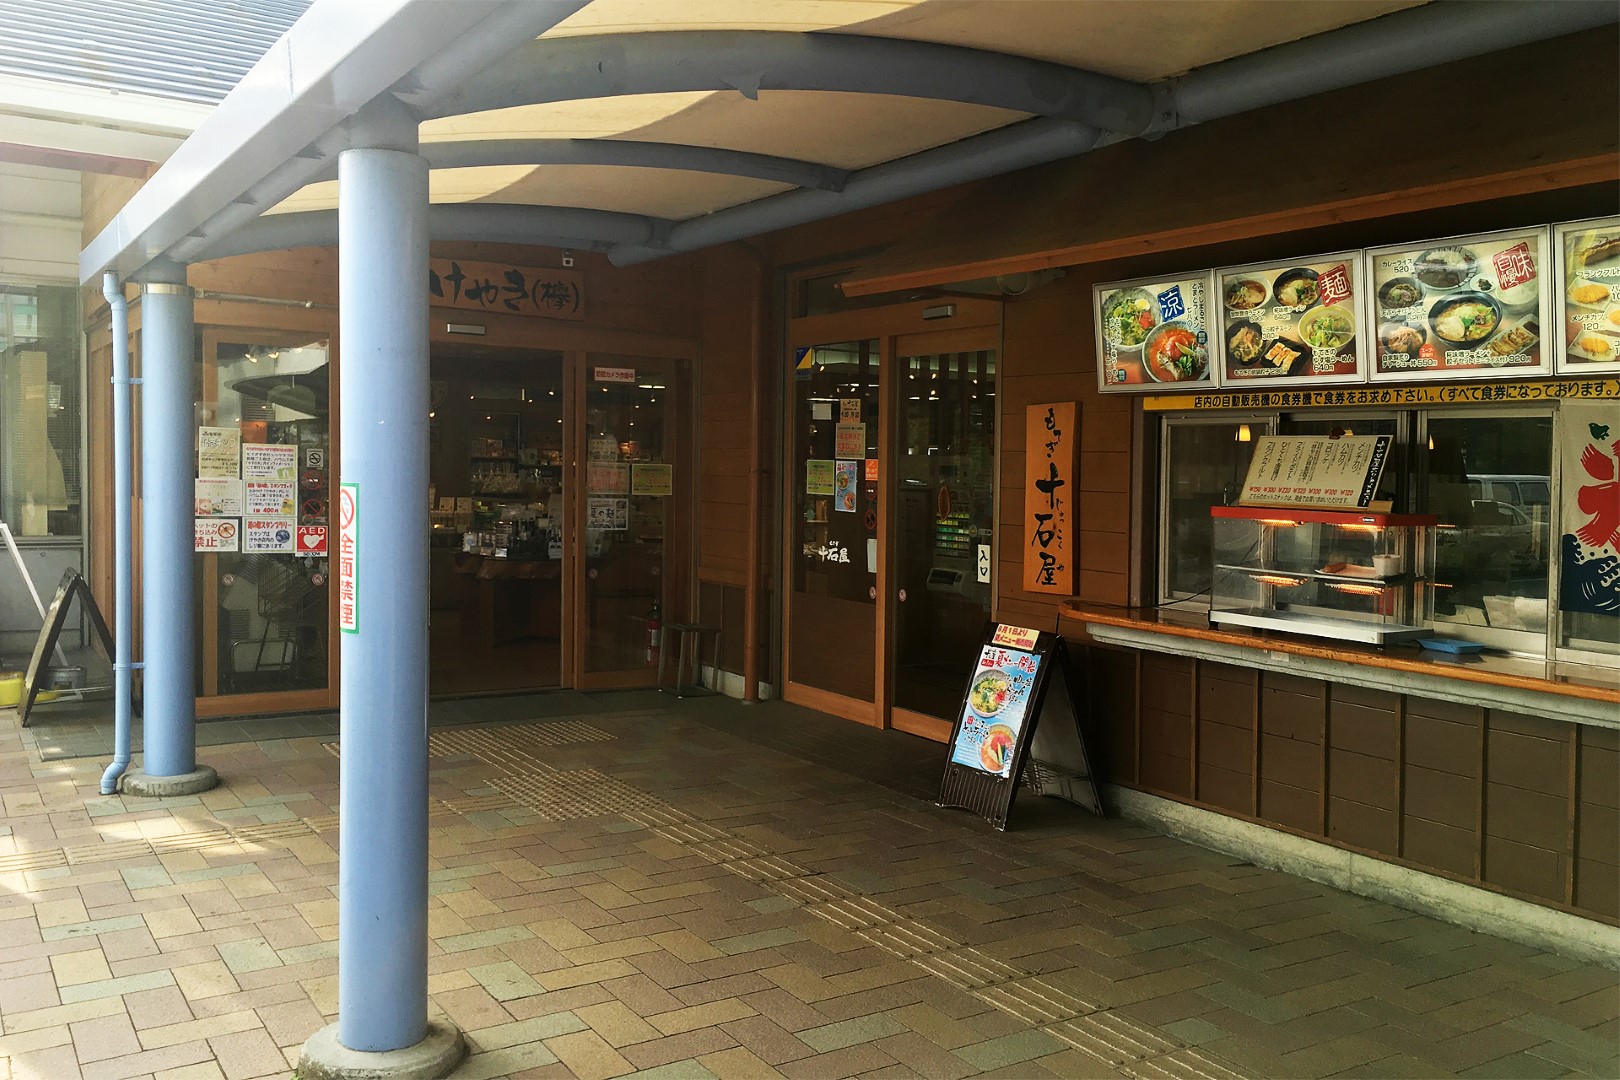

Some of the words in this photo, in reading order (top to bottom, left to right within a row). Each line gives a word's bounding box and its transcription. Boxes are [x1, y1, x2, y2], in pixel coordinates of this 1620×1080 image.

[1382, 258, 1412, 268] カレーライス
[1160, 291, 1183, 319] 涼
[195, 536, 218, 548] 禁止
[818, 545, 851, 563] 十石屋
[980, 550, 988, 576] 入口
